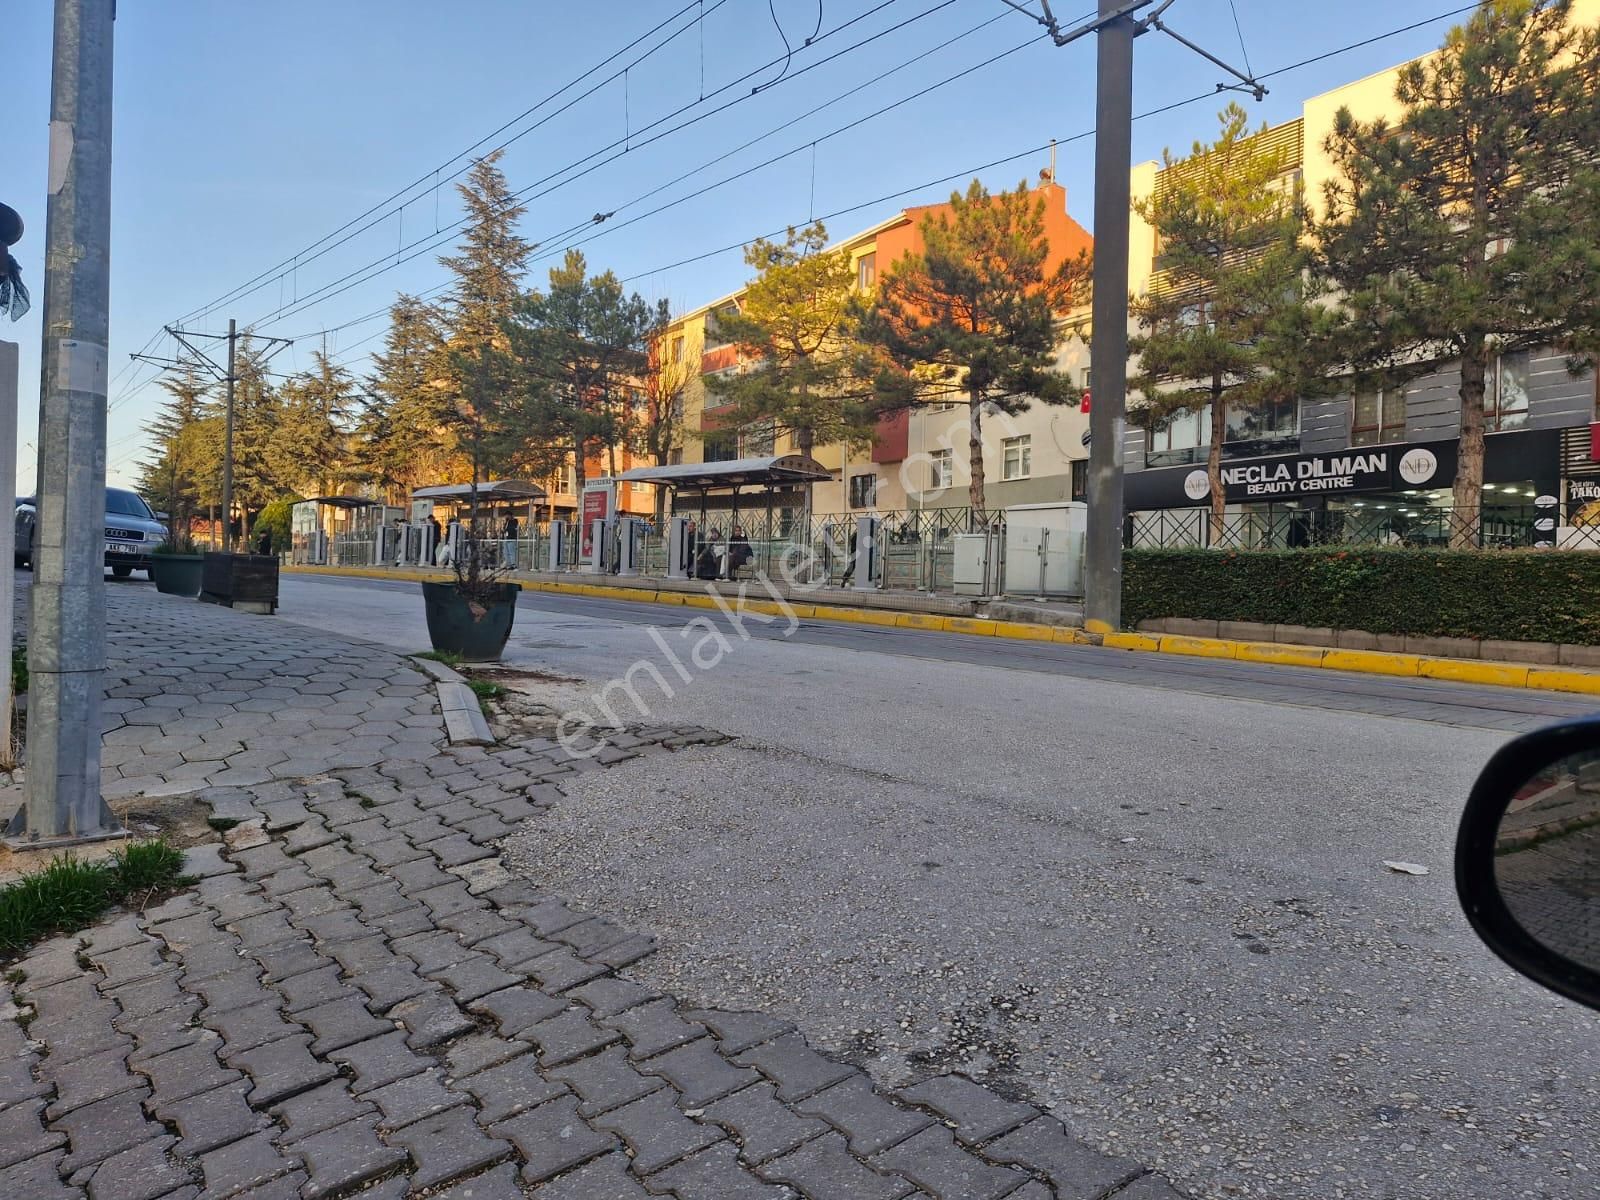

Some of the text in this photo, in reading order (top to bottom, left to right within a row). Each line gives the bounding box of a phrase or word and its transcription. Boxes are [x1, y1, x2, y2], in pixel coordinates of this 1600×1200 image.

[1221, 453, 1387, 485] NECLA DİLMAN
[1405, 457, 1430, 474] ND
[1247, 476, 1354, 495] BEAUTY CENTRE
